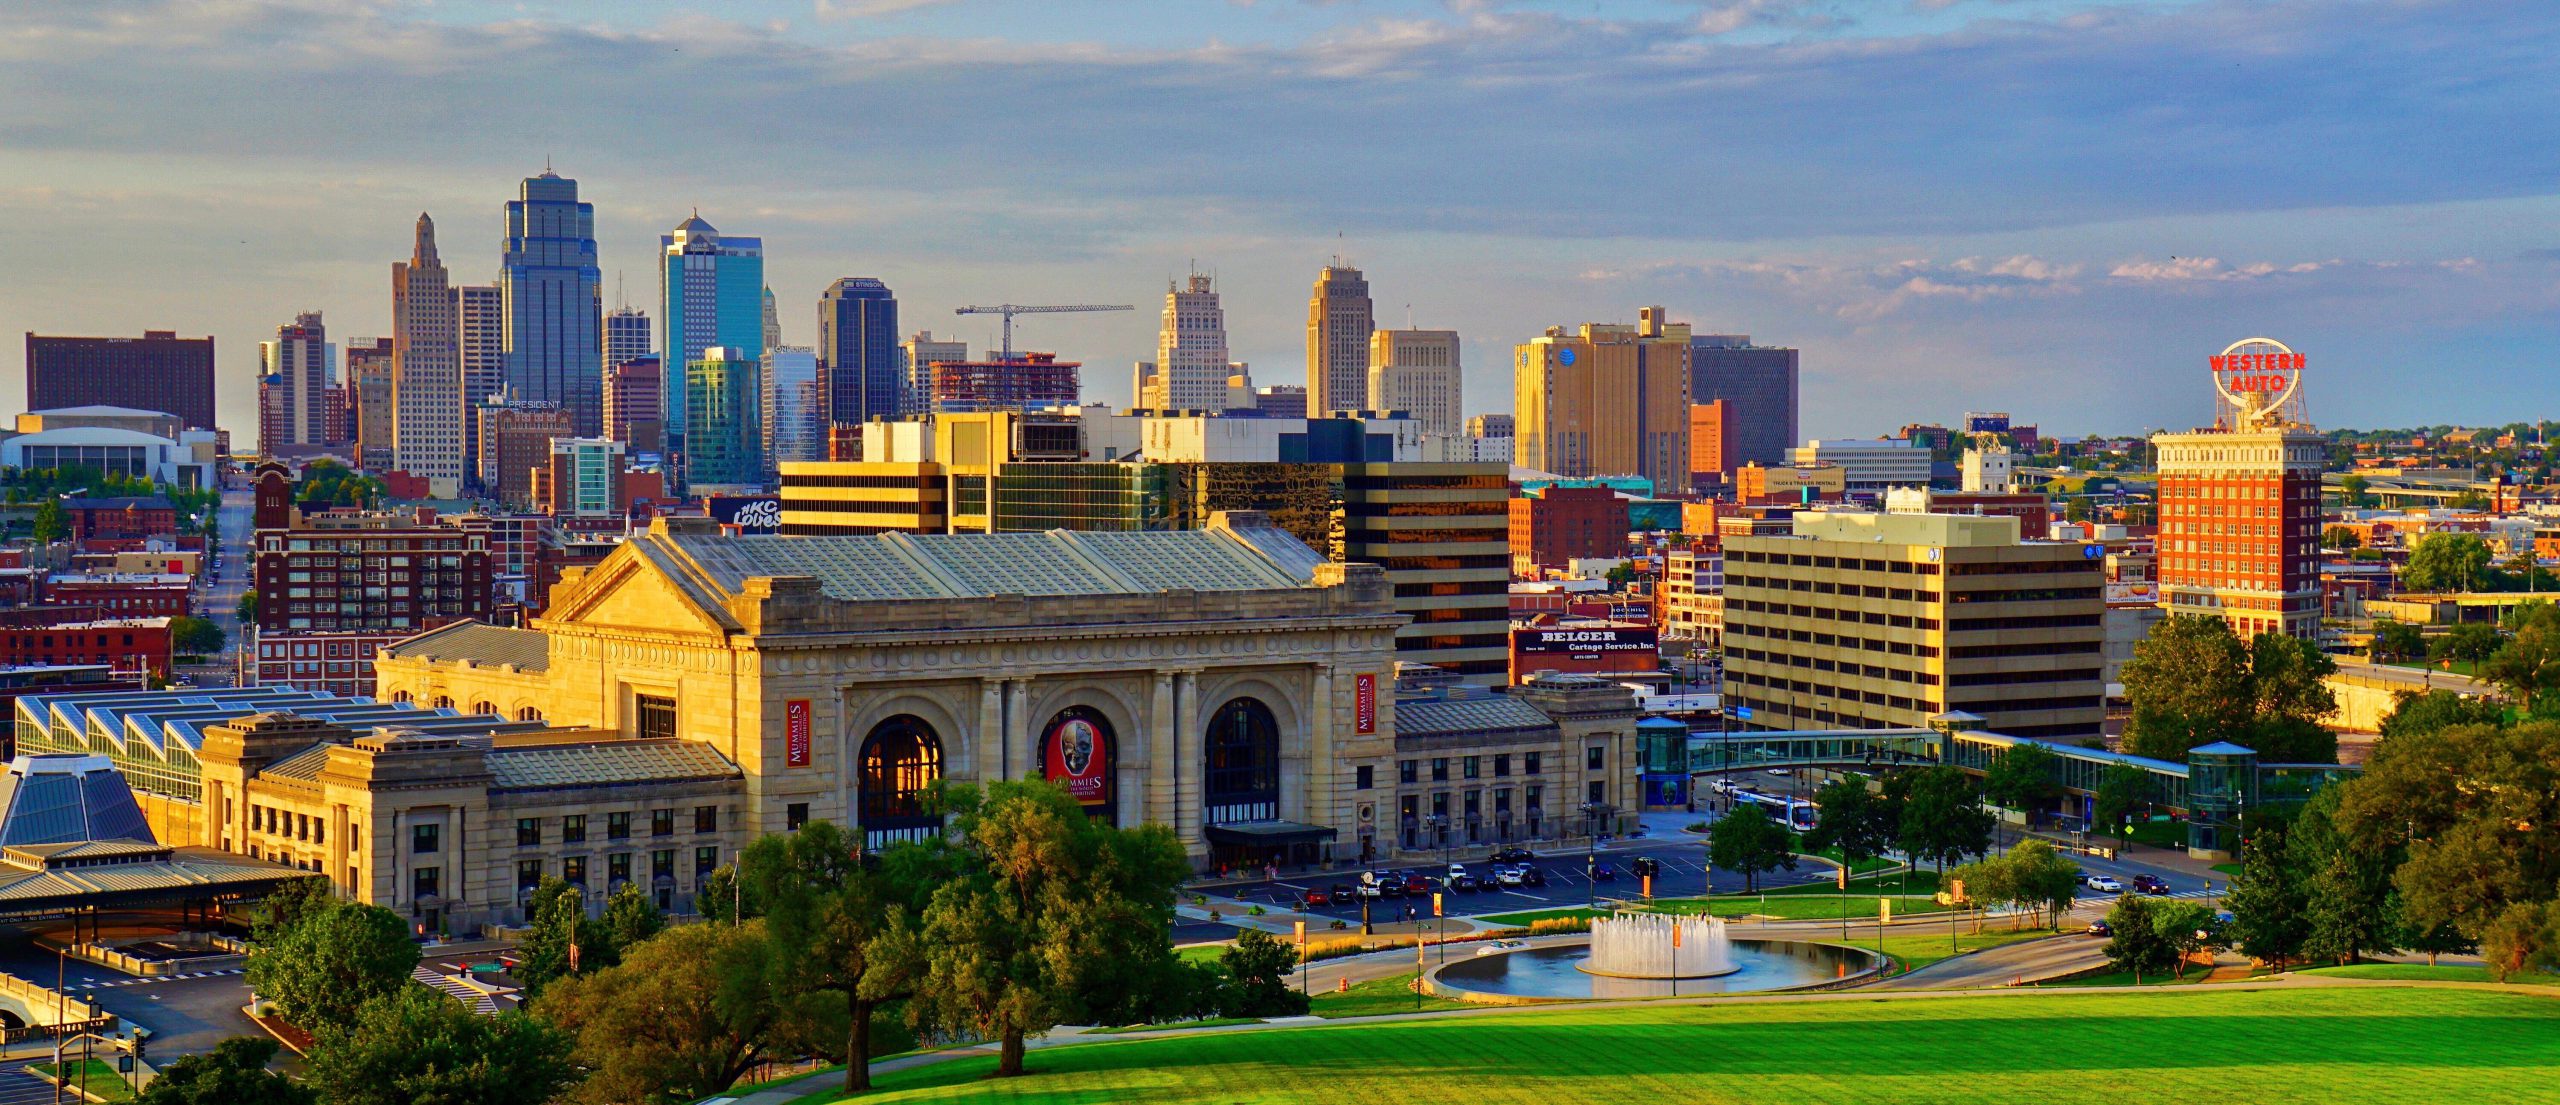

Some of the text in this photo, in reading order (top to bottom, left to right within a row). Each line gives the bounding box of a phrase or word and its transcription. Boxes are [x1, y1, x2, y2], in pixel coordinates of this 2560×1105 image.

[2209, 353, 2306, 371] WESTERN
[2230, 375, 2286, 392] AUTO
[508, 400, 560, 409] PRESIDENT
[741, 501, 778, 515] #KC
[1541, 631, 1617, 642] BELGER
[1568, 643, 1603, 652] Cartage
[1359, 678, 1368, 730] MUMMIES
[790, 705, 801, 762] MUMMIES
